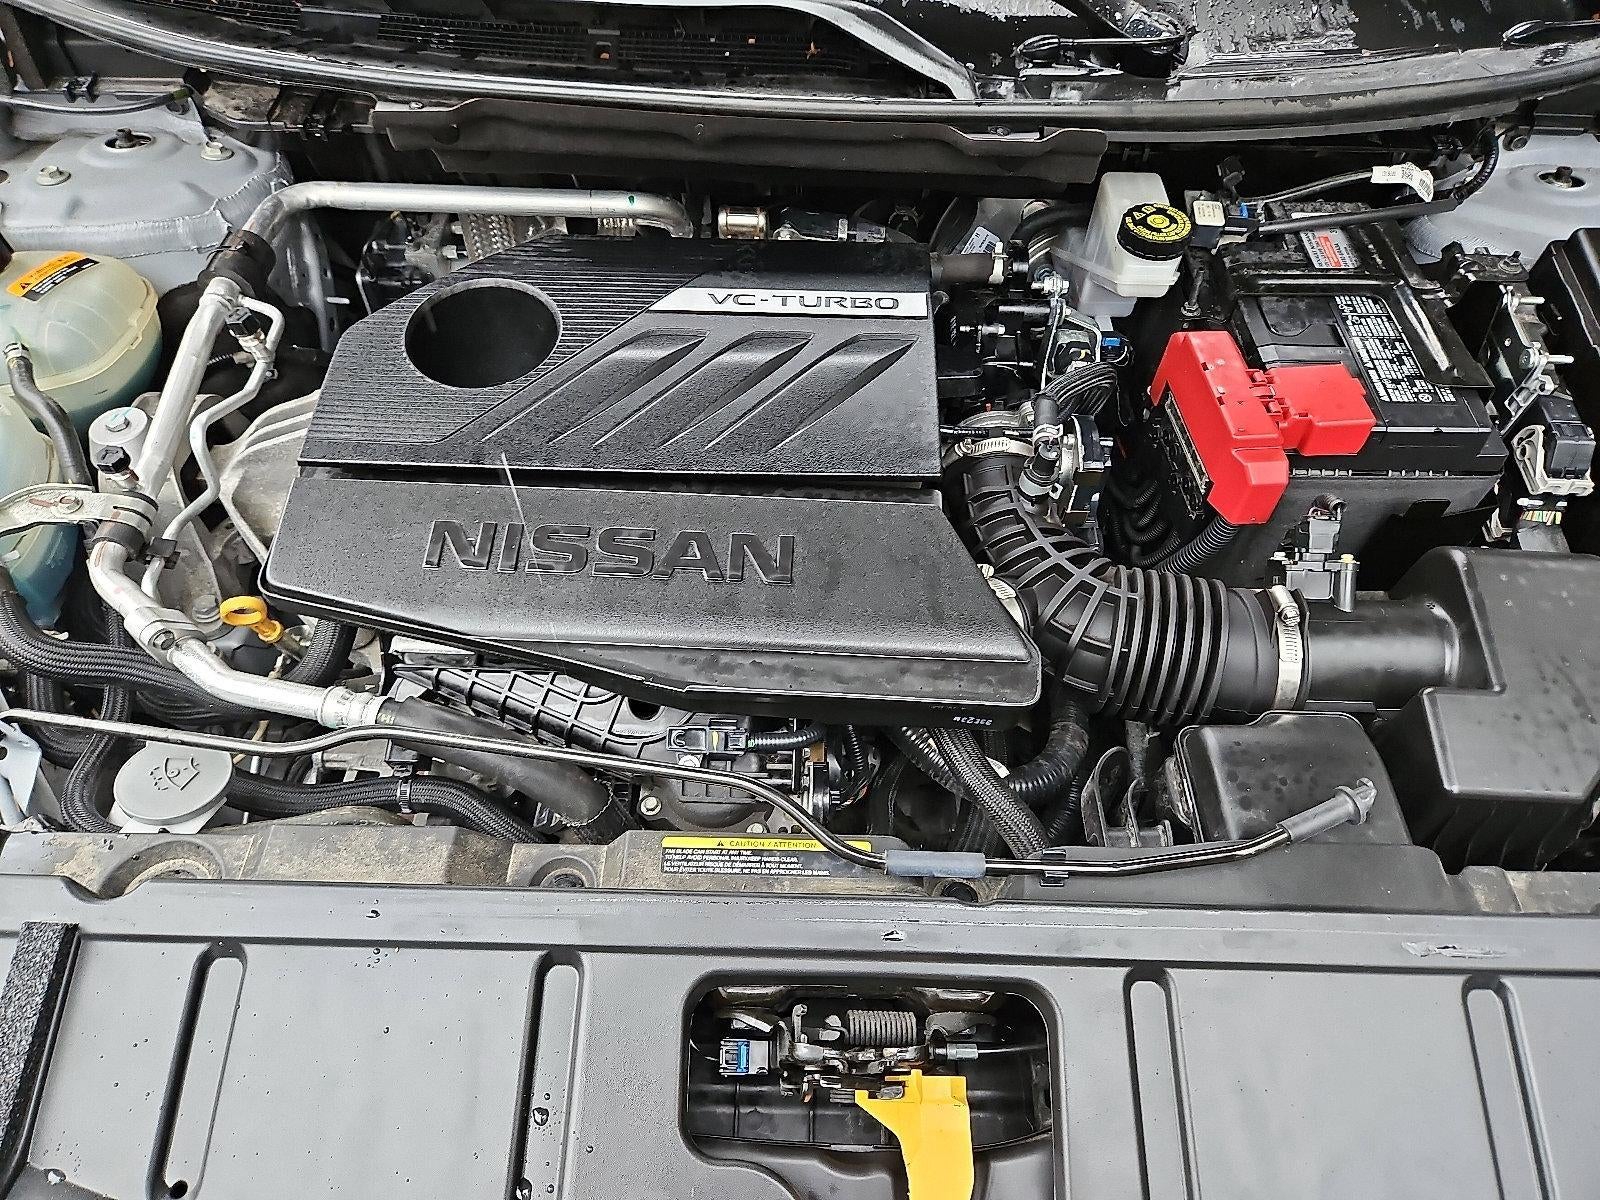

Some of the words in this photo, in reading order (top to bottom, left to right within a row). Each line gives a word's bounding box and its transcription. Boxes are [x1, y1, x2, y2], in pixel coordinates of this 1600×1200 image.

[707, 292, 900, 310] VC-TURBO
[422, 519, 796, 586] NISSAN
[729, 840, 763, 848] CAUTION
[773, 841, 816, 849] ATTENTION
